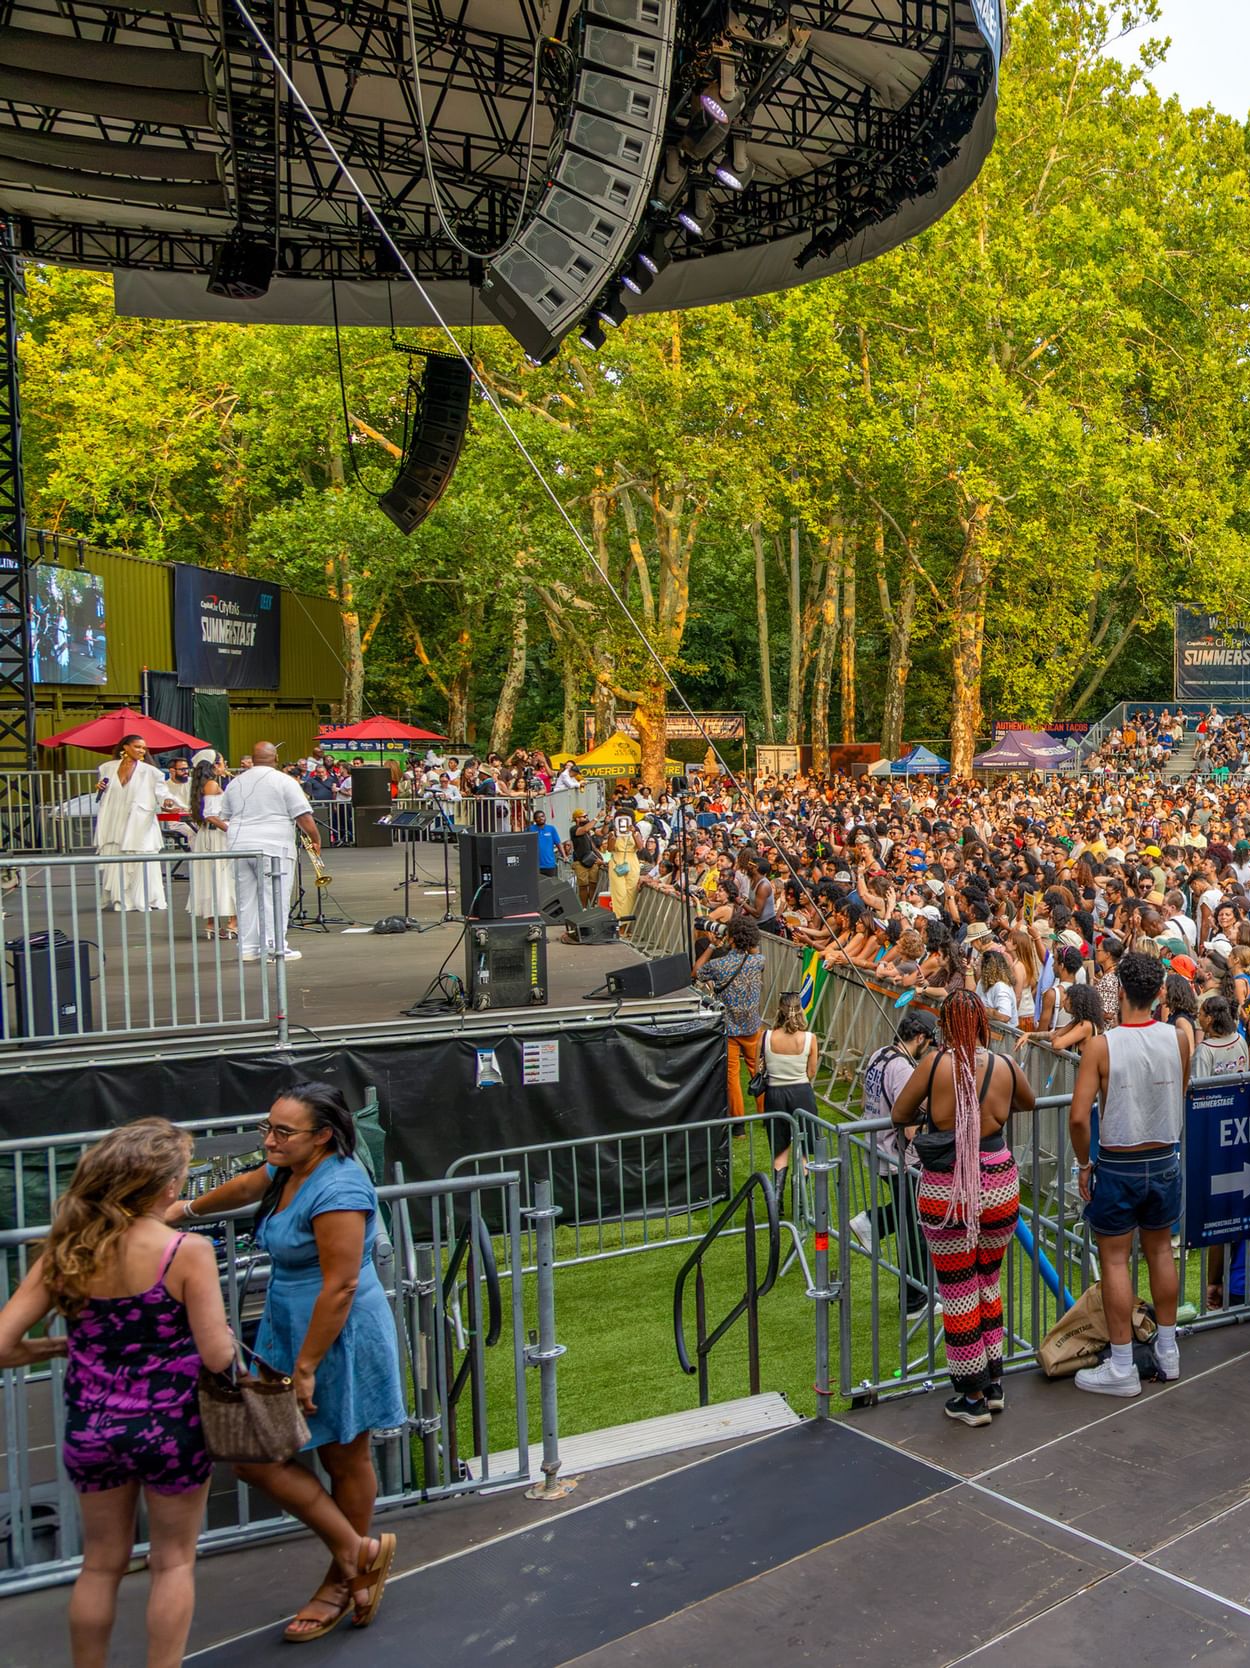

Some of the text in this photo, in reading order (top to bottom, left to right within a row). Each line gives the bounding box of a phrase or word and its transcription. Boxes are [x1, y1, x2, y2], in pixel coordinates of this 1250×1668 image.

[201, 616, 257, 647] SUMMERSTAGE
[1066, 723, 1089, 732] TACOS
[580, 766, 626, 776] OWERED
[1192, 1097, 1235, 1110] SUMMERSTAGE
